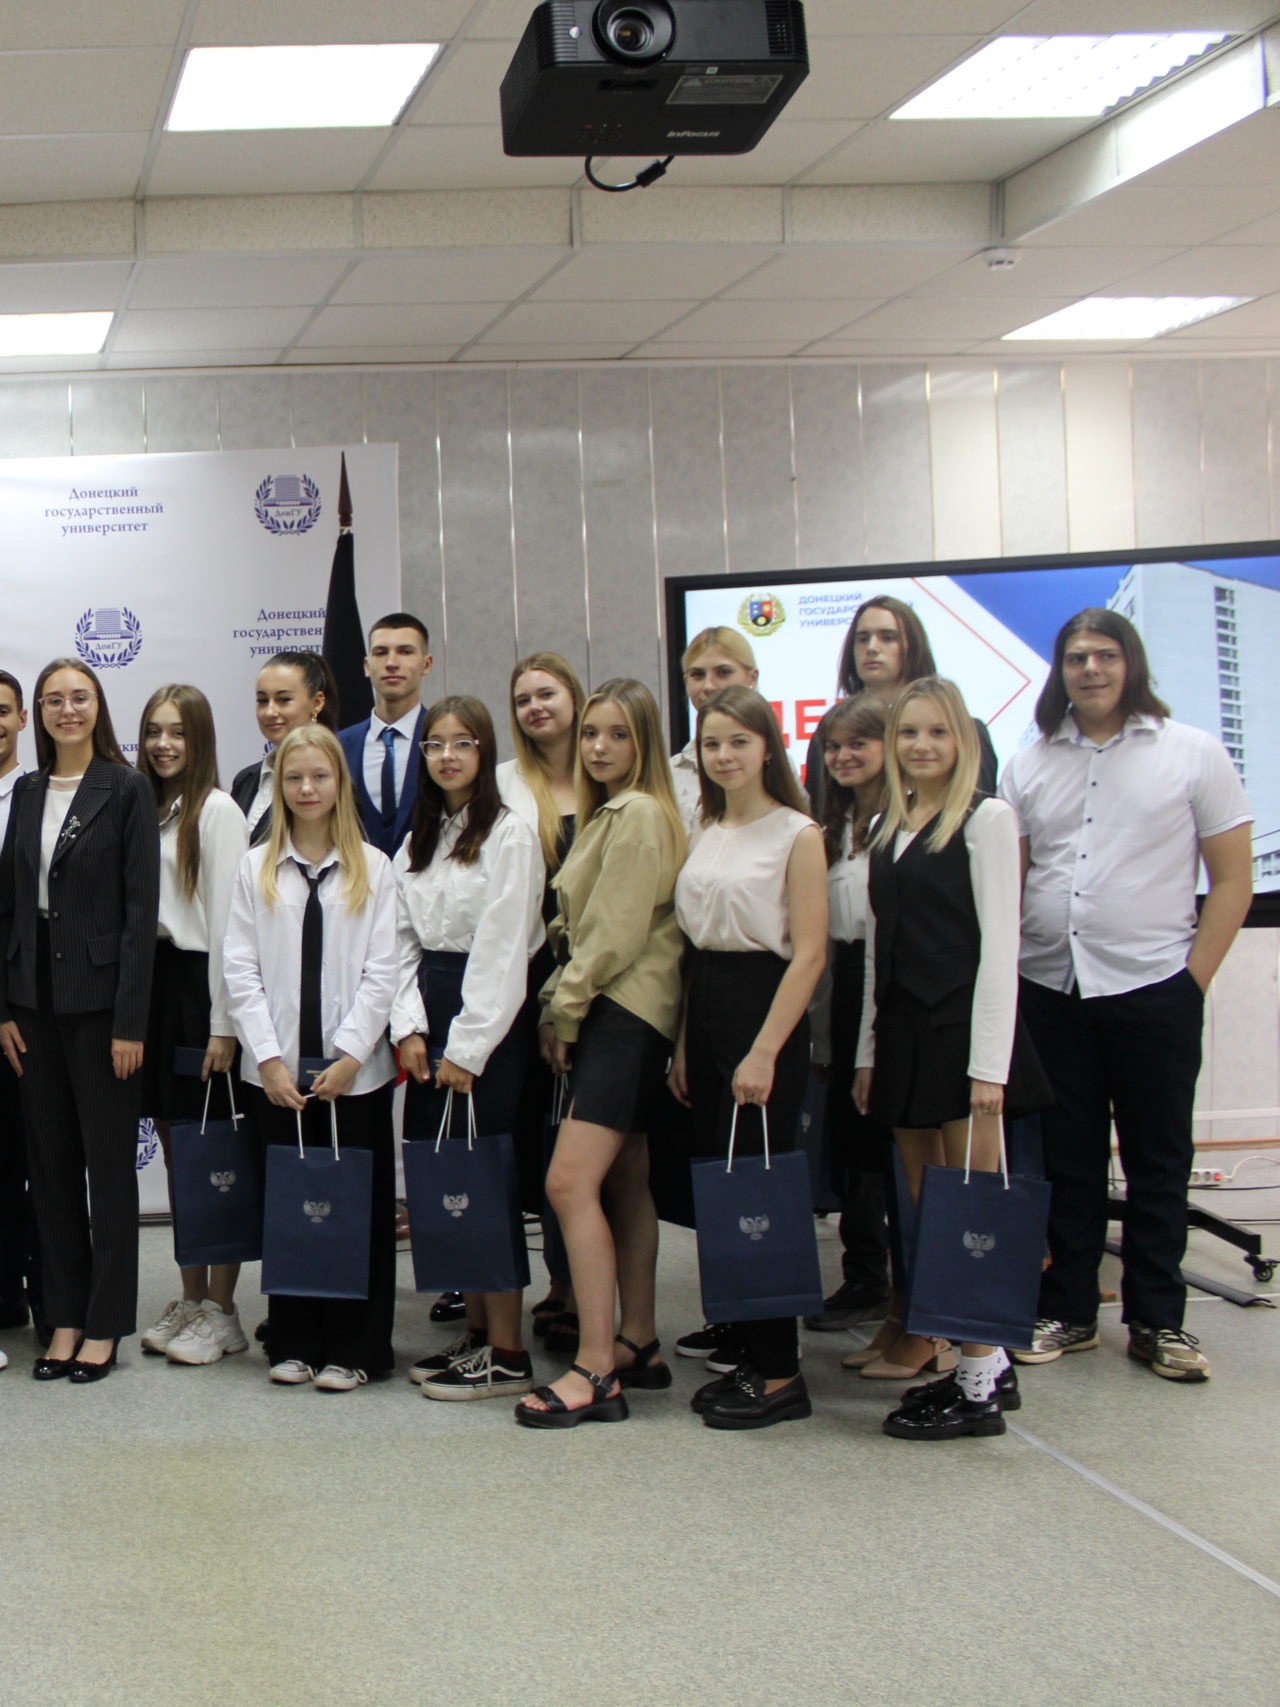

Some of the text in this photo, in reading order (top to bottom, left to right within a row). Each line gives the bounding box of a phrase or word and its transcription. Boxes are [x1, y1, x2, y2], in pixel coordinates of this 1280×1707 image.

[666, 130, 721, 138] InFocus
[69, 487, 138, 501] Донецкий
[45, 503, 164, 519] государственный
[61, 522, 148, 537] университет
[798, 592, 862, 605] ДОНЕЦКИЙ
[257, 608, 326, 622] Донецкий
[800, 616, 853, 627] УНИВЕРС
[233, 626, 324, 641] государствен
